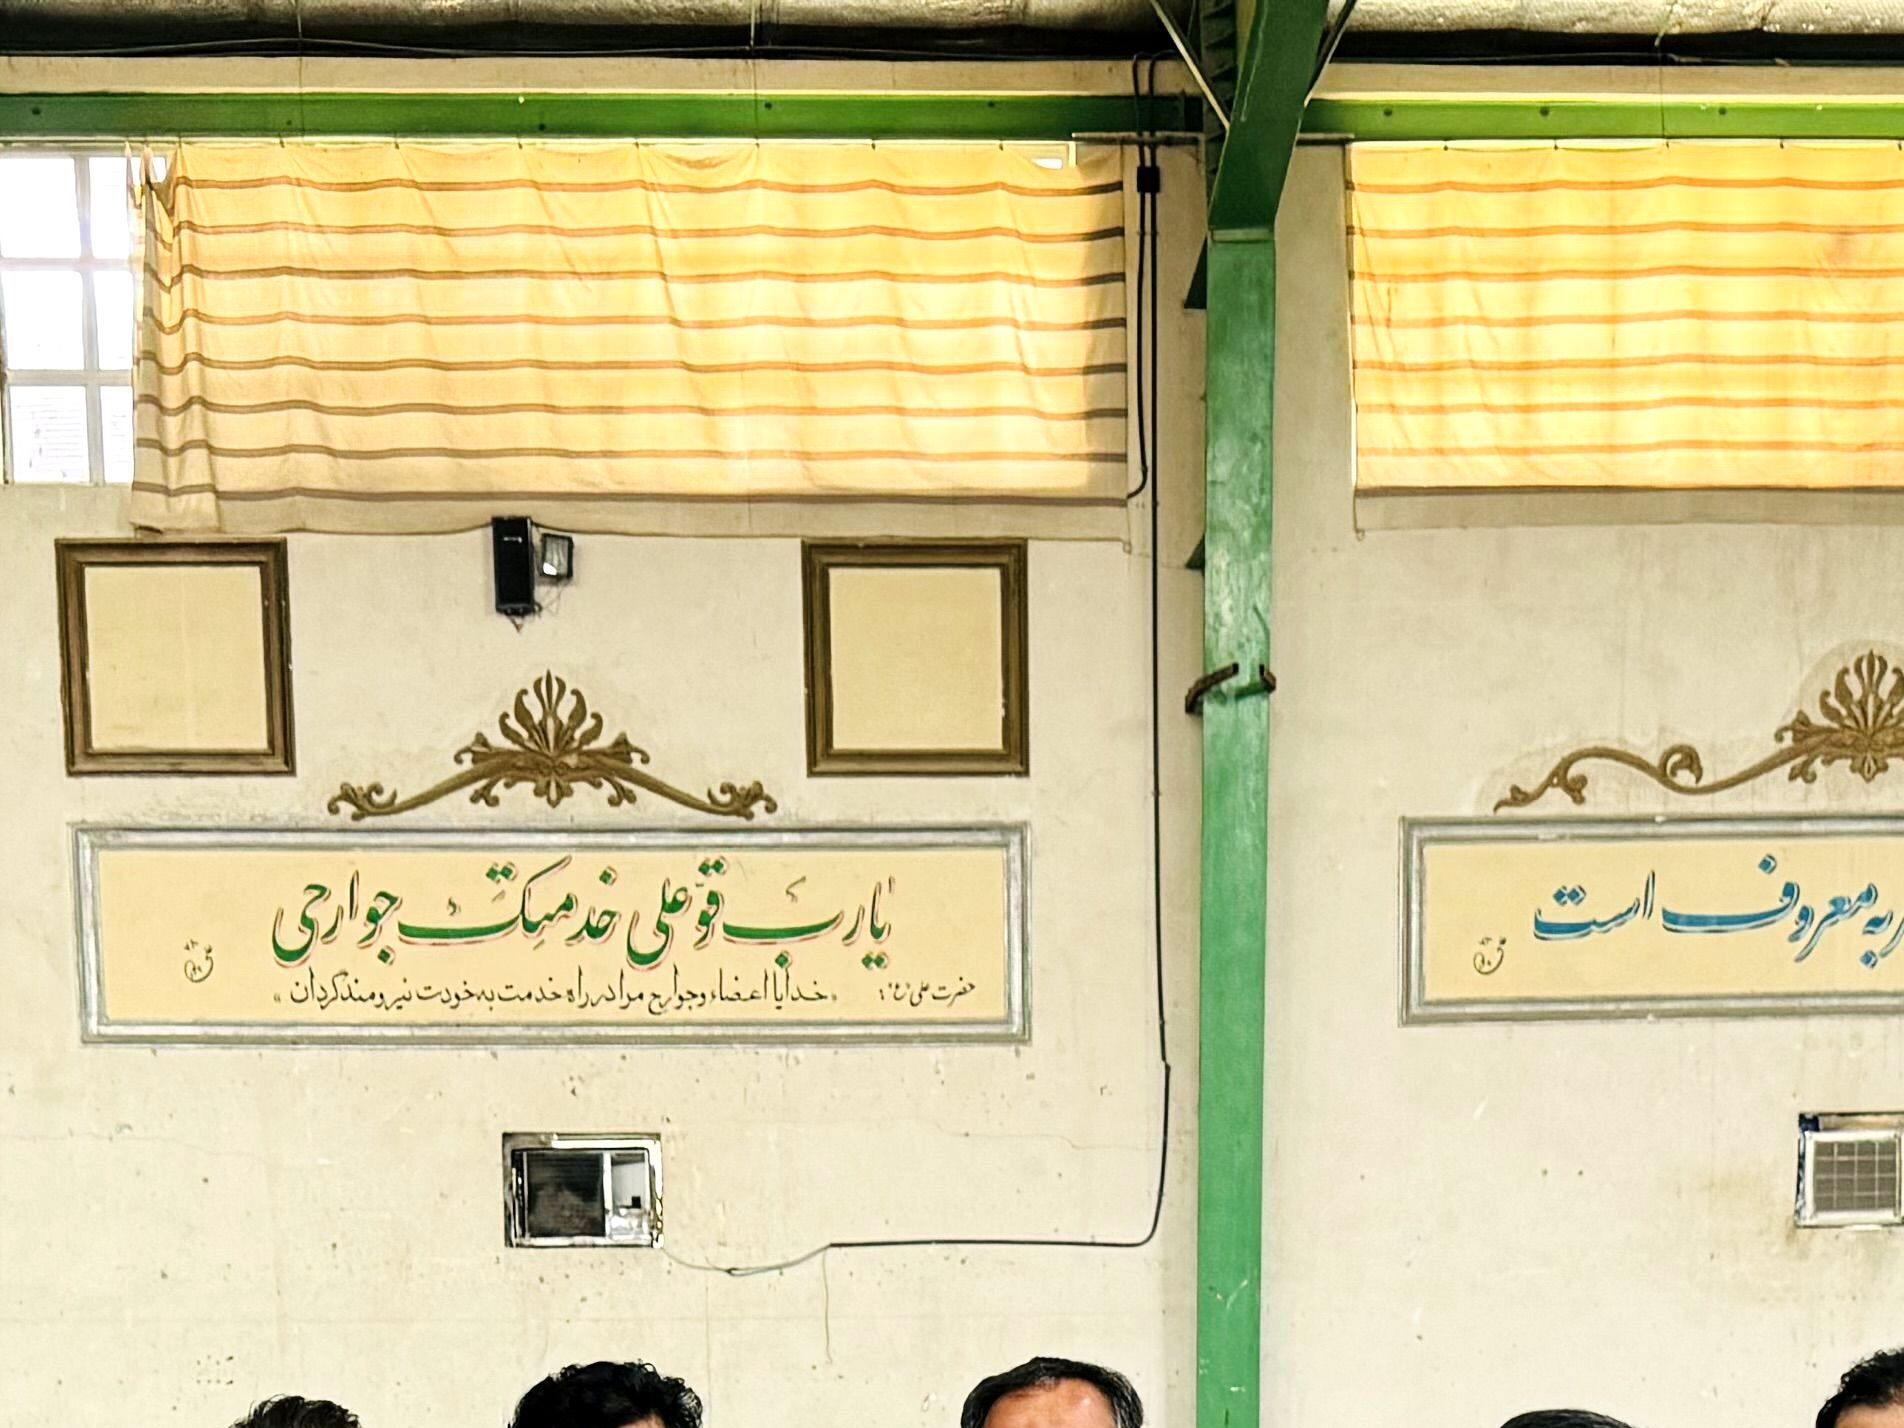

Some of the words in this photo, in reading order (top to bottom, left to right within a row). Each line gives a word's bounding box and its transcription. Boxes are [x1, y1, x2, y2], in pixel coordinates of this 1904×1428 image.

[271, 868, 403, 967] جوارحی
[626, 877, 693, 972] علی
[1533, 869, 1656, 941] است
[1662, 853, 1879, 963] معروف
[1860, 909, 1894, 969] به
[498, 977, 562, 1003] خدمت
